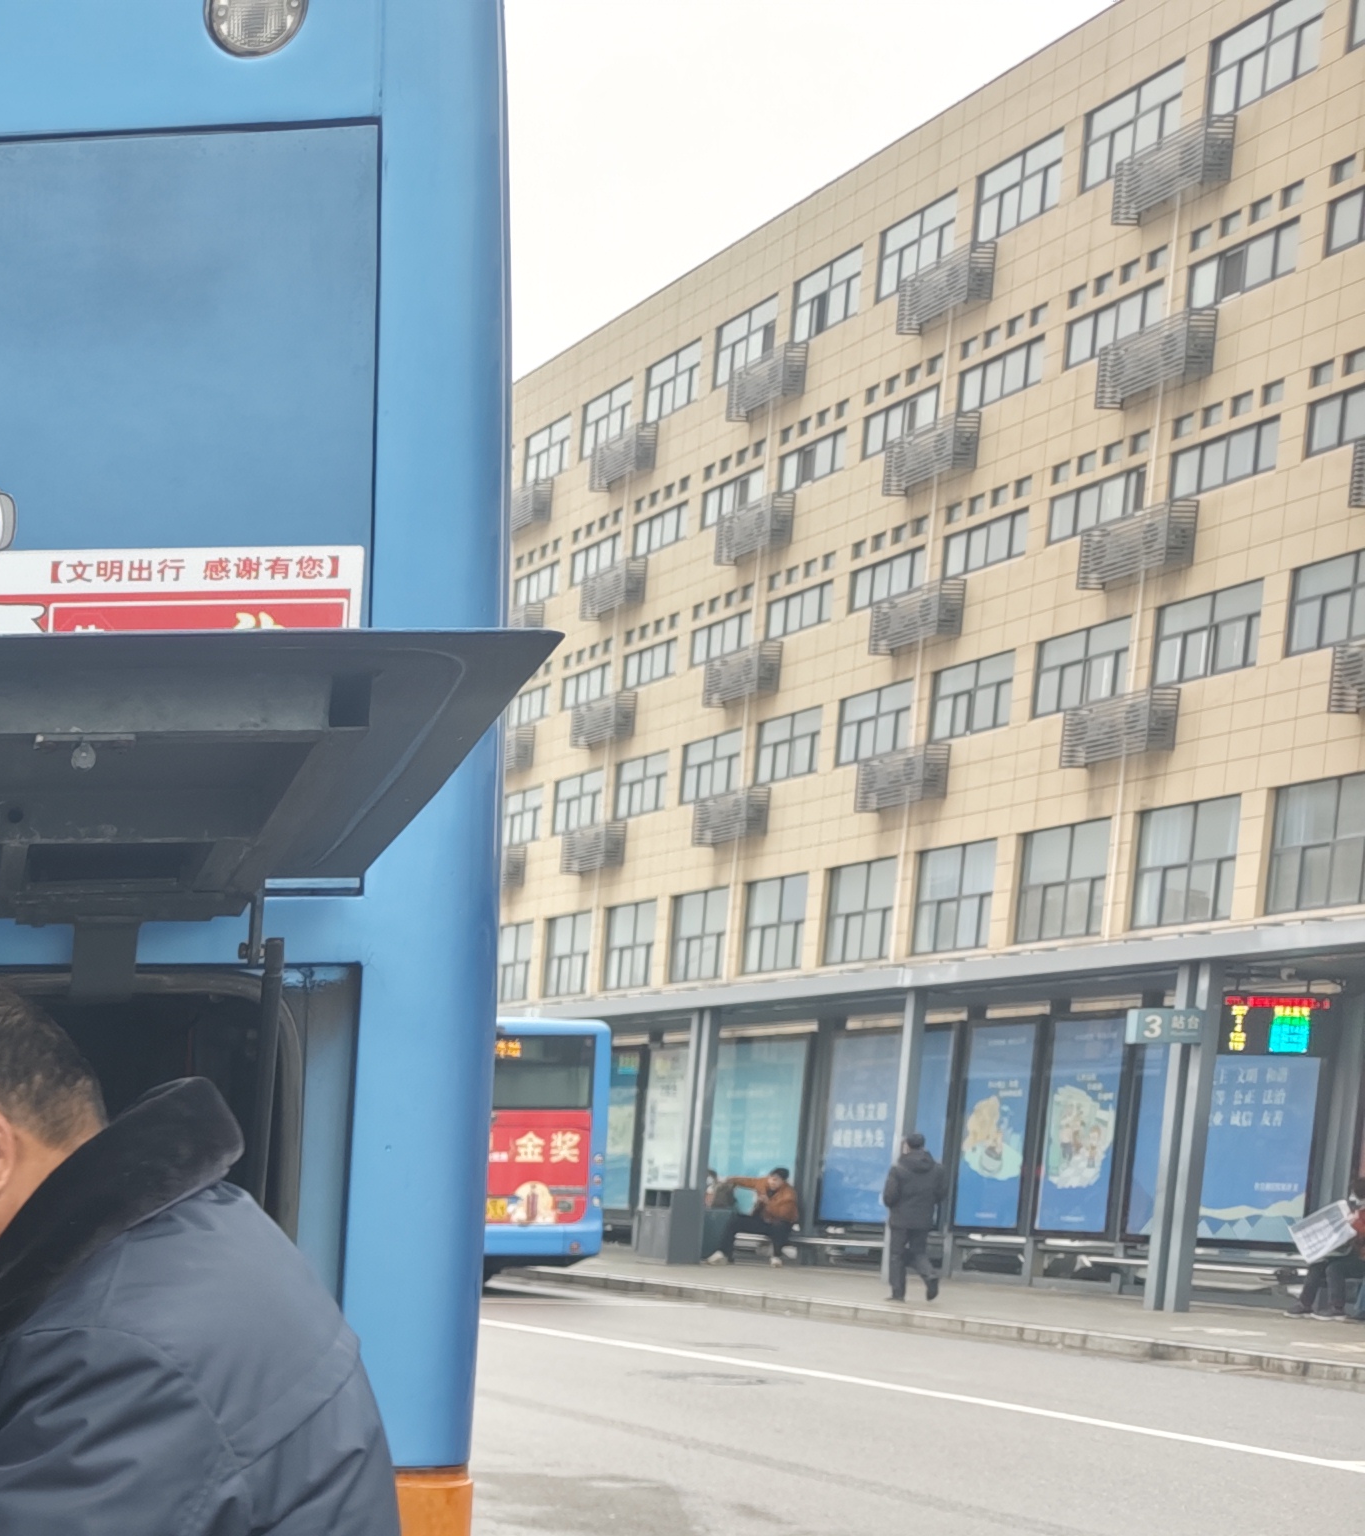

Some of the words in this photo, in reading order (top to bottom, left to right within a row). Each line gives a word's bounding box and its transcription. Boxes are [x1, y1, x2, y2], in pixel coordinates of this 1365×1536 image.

[1143, 1014, 1163, 1038] 3
[1170, 1014, 1201, 1030] 站台
[514, 1130, 581, 1164] 金奖
